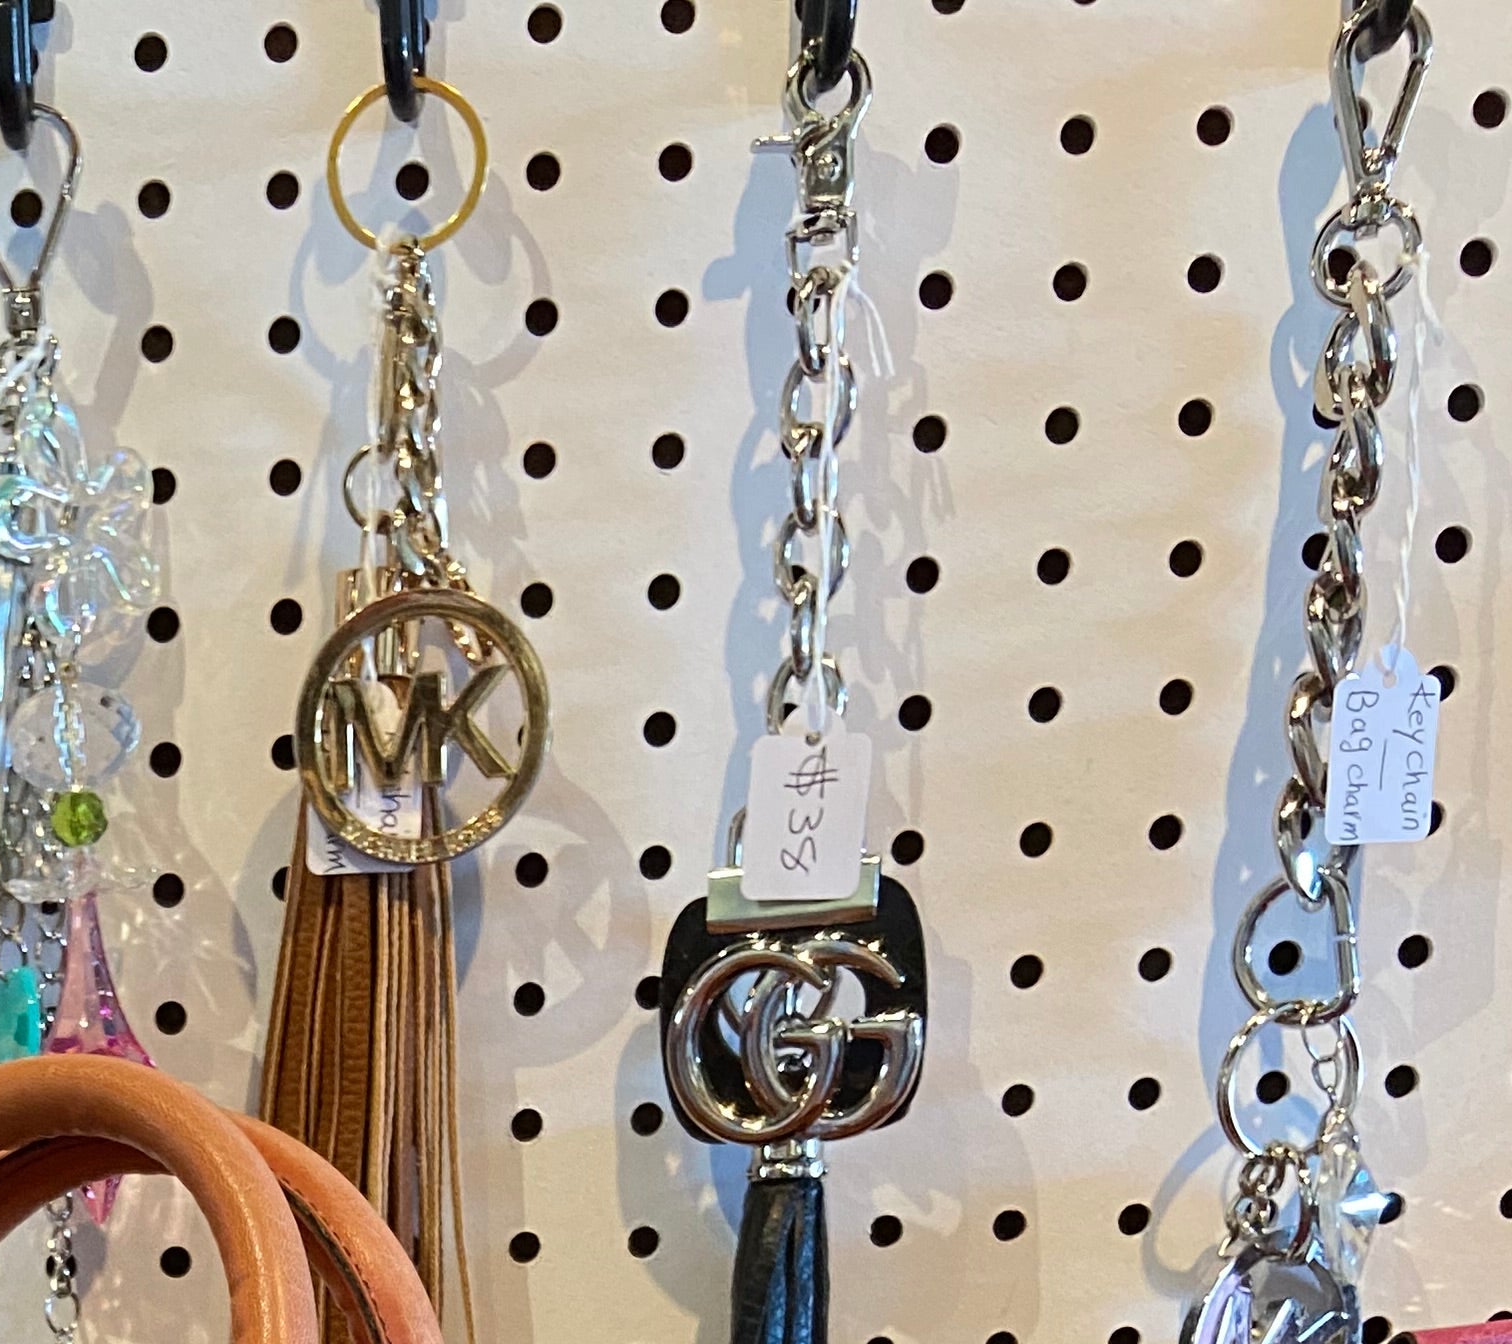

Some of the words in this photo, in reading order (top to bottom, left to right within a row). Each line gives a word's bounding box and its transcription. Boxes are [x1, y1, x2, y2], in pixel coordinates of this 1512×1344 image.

[325, 663, 518, 792] MK
[1339, 690, 1380, 753] Bag
[1392, 682, 1436, 832] Keychain
[1340, 764, 1368, 841] charm
